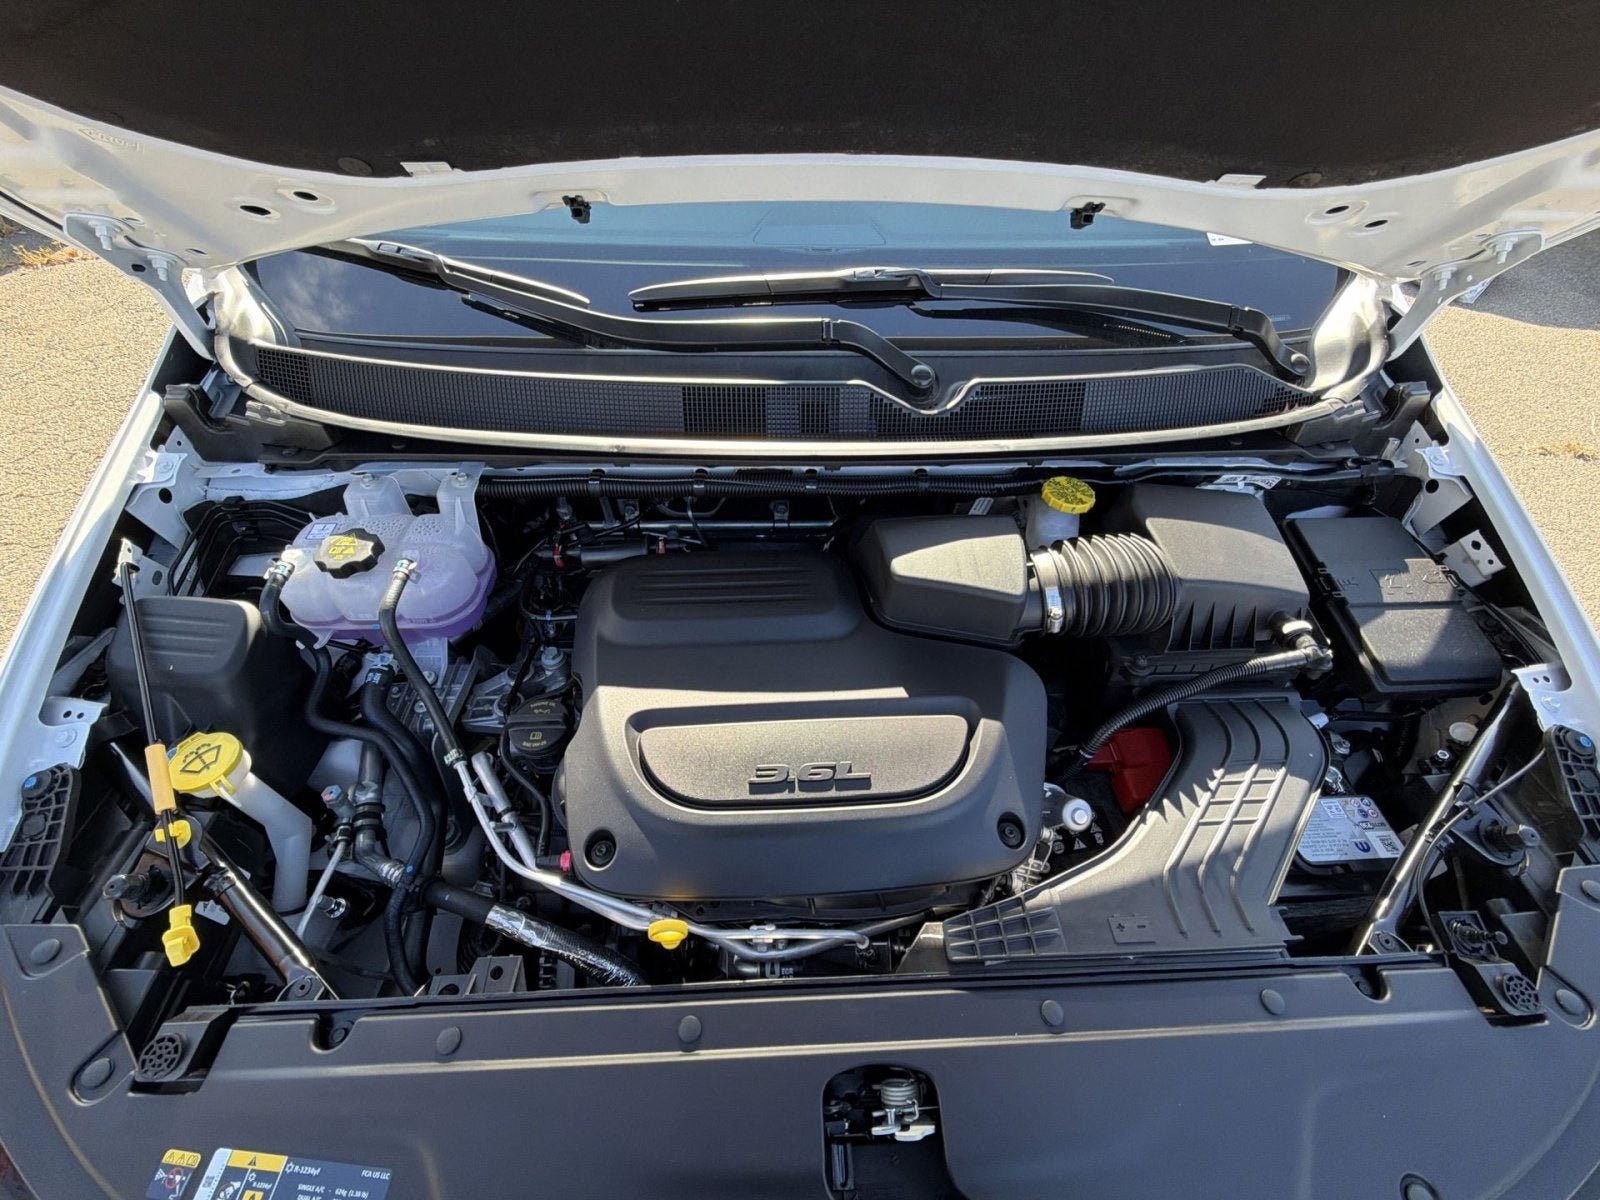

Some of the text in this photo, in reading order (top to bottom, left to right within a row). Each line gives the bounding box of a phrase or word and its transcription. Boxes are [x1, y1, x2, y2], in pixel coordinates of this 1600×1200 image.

[748, 761, 872, 787] 3.6L
[361, 1169, 391, 1180] FCA US LLC
